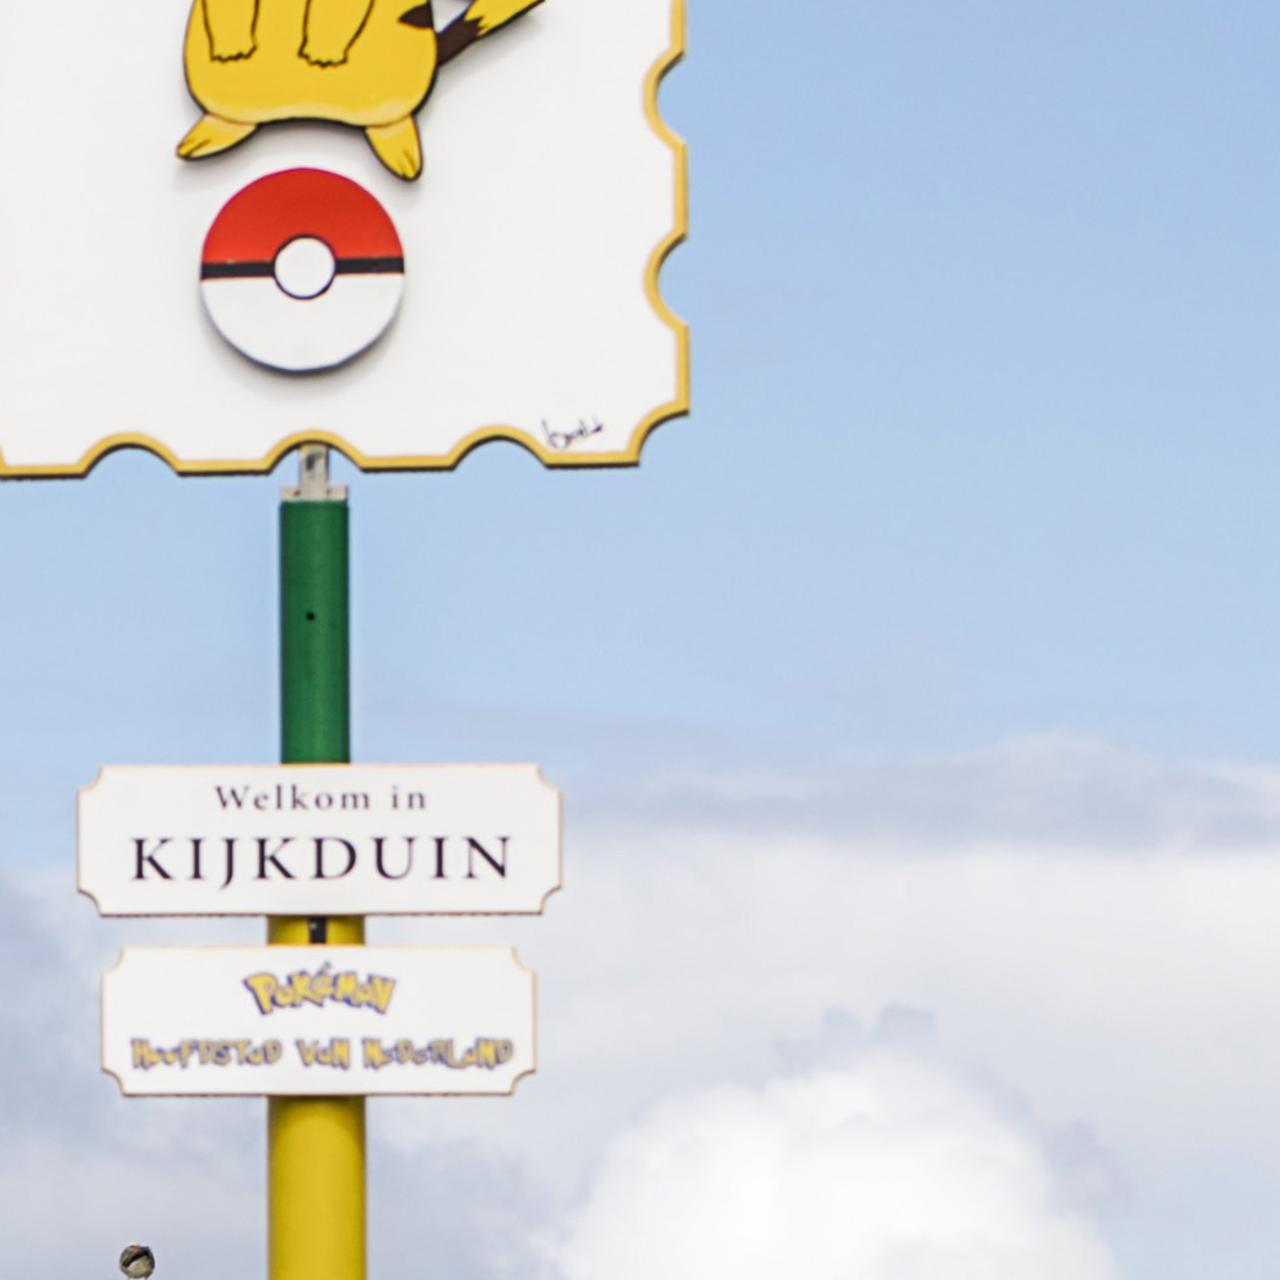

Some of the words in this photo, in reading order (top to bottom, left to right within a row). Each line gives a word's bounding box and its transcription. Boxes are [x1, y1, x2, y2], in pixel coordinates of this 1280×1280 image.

[214, 784, 371, 811] Welkom
[391, 784, 427, 811] in
[130, 835, 514, 890] KIJKDUIN
